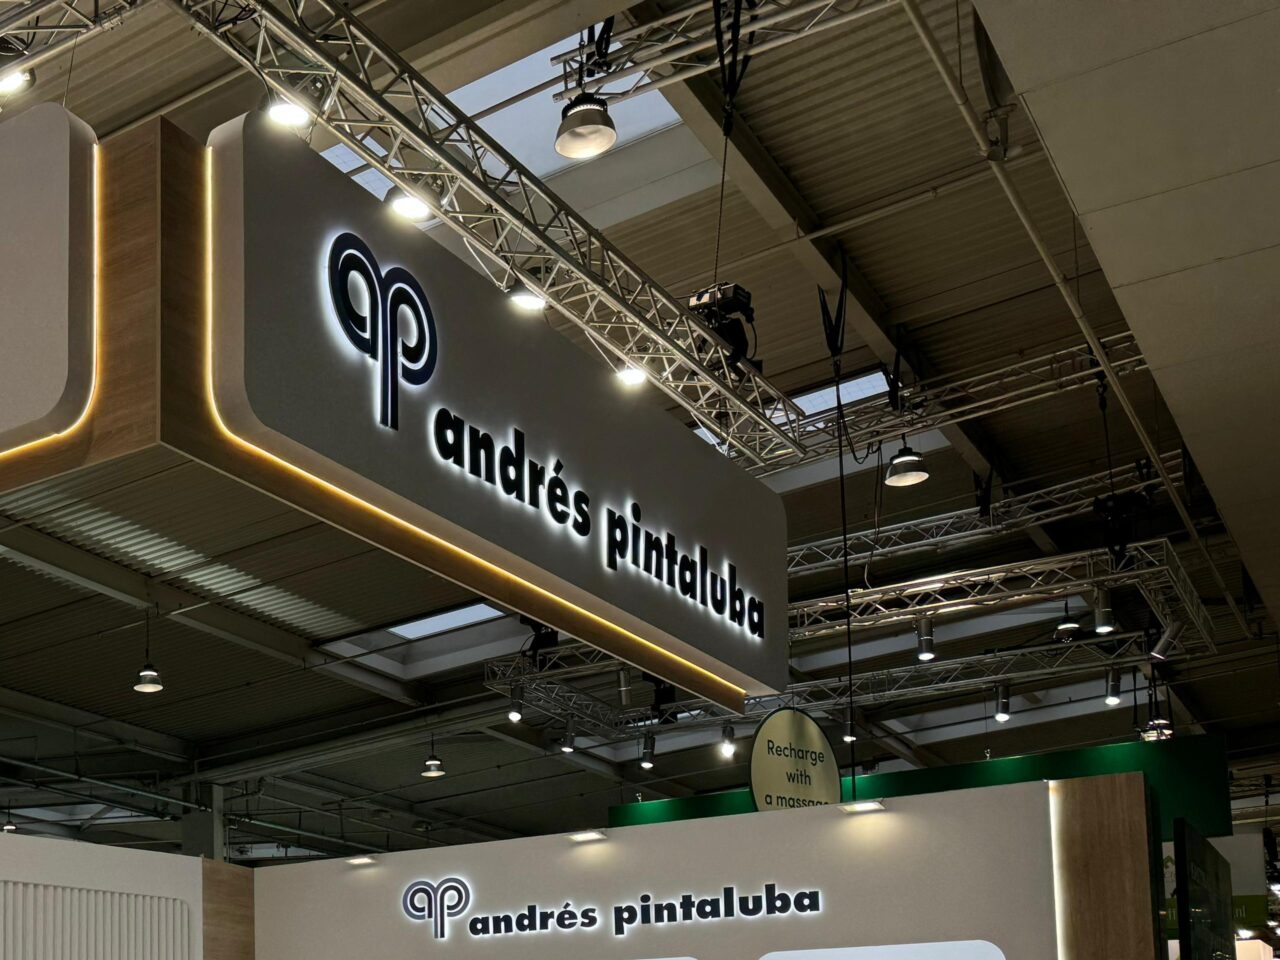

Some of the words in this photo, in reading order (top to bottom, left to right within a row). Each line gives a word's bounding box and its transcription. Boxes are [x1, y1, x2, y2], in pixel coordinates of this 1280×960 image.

[433, 406, 591, 538] andrés
[606, 501, 765, 640] pintaluba
[767, 739, 824, 766] Recharge
[786, 768, 811, 785] with
[764, 794, 772, 805] a
[468, 901, 599, 937] andrés
[613, 882, 821, 936] pintaluba
